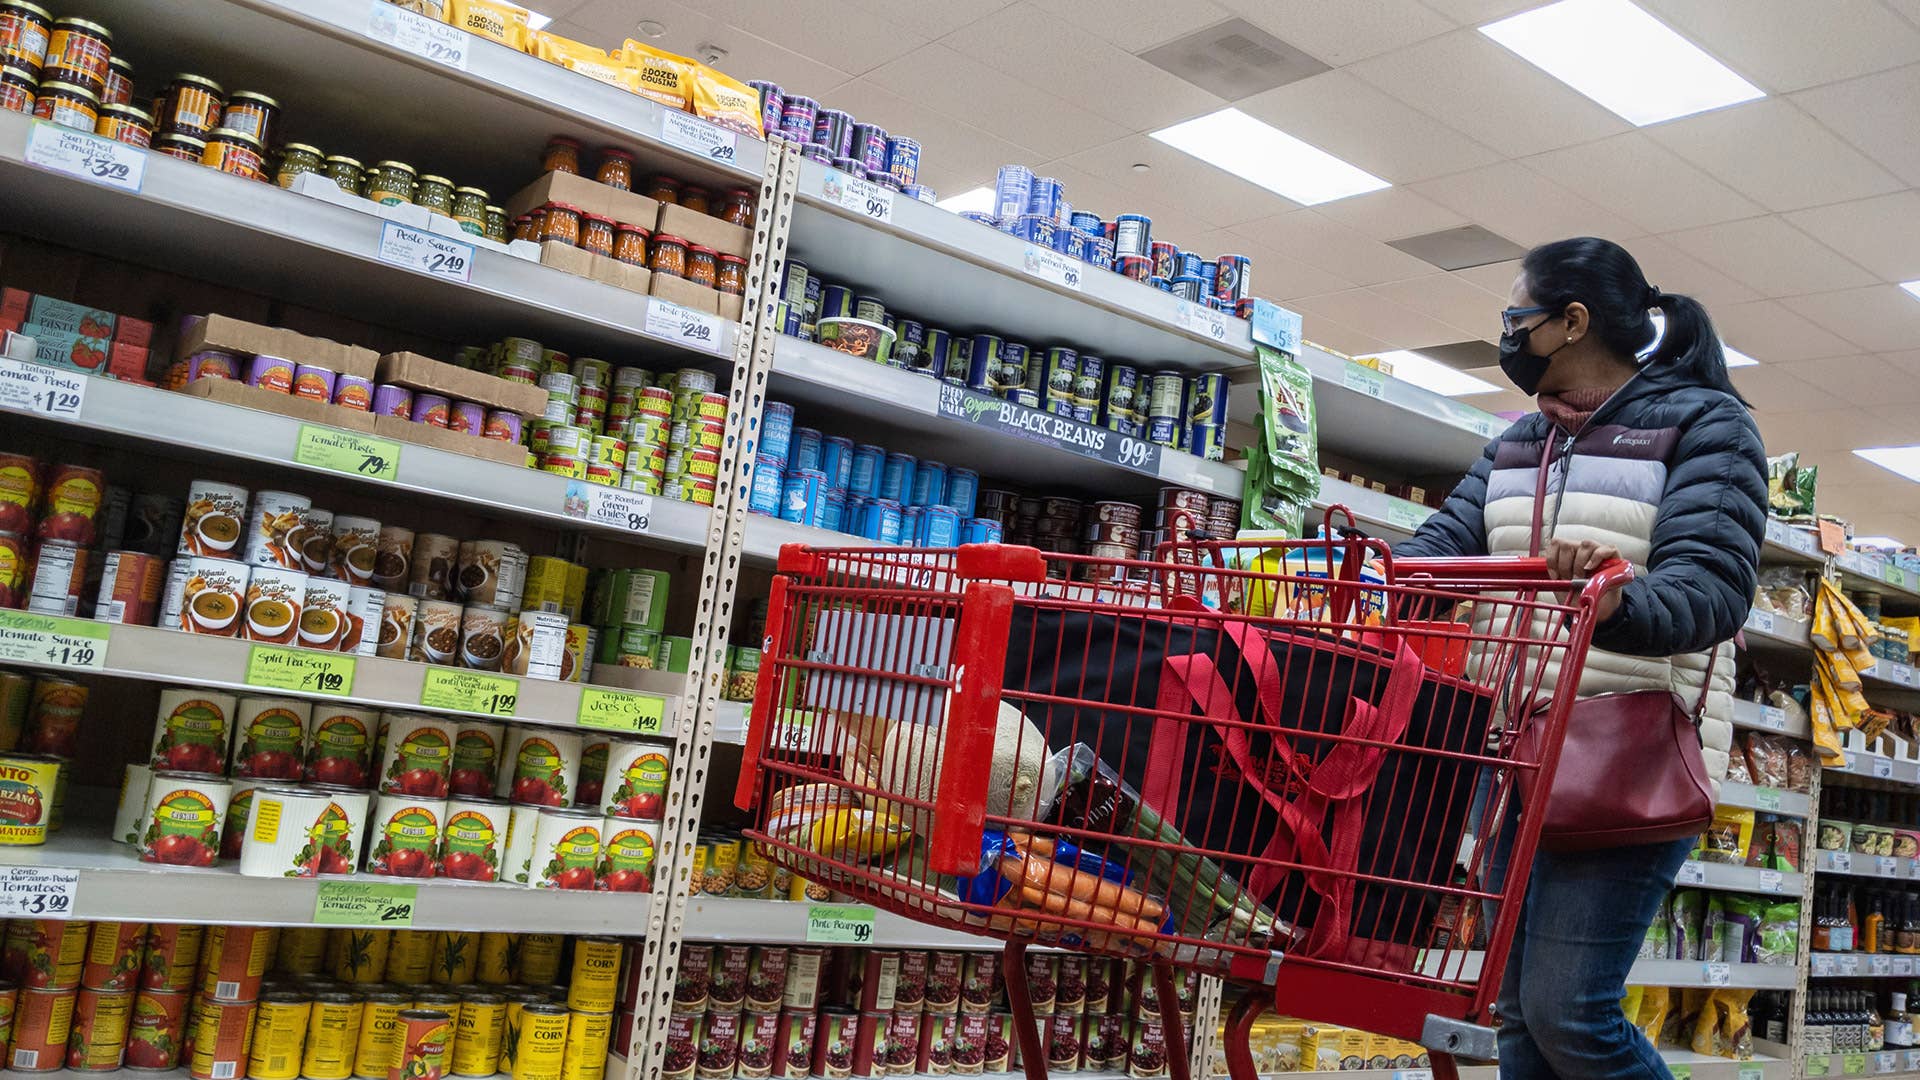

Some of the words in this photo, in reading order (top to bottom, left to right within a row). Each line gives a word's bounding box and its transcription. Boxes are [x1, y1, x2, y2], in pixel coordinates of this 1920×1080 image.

[641, 74, 678, 88] COUSINS
[648, 68, 678, 81] DOZEN
[58, 140, 116, 160] Tomatoes
[86, 138, 113, 154] Dried
[396, 229, 424, 245] Pesto
[427, 239, 457, 254] Sauce
[21, 364, 55, 376] Italian
[0, 368, 39, 383] omato
[44, 375, 80, 391] Paste
[964, 396, 1001, 423] Organic
[998, 402, 1053, 436] BLACK
[1051, 419, 1106, 450] BEANS
[310, 434, 347, 450] Tomato
[348, 441, 376, 455] Paste
[597, 508, 627, 519] Chiles
[602, 501, 629, 513] Green
[537, 616, 558, 624] Nutrition
[52, 634, 92, 648] Sauce
[258, 652, 283, 664] Split
[305, 659, 331, 672] Soup
[436, 677, 458, 687] Lentil
[458, 680, 500, 692] Vegetable
[590, 700, 620, 712] Joe's
[623, 702, 641, 714] O's
[3, 882, 66, 894] Tomatoes
[812, 919, 832, 929] Pinto
[586, 959, 615, 969] CORN
[534, 1030, 563, 1040] CORN
